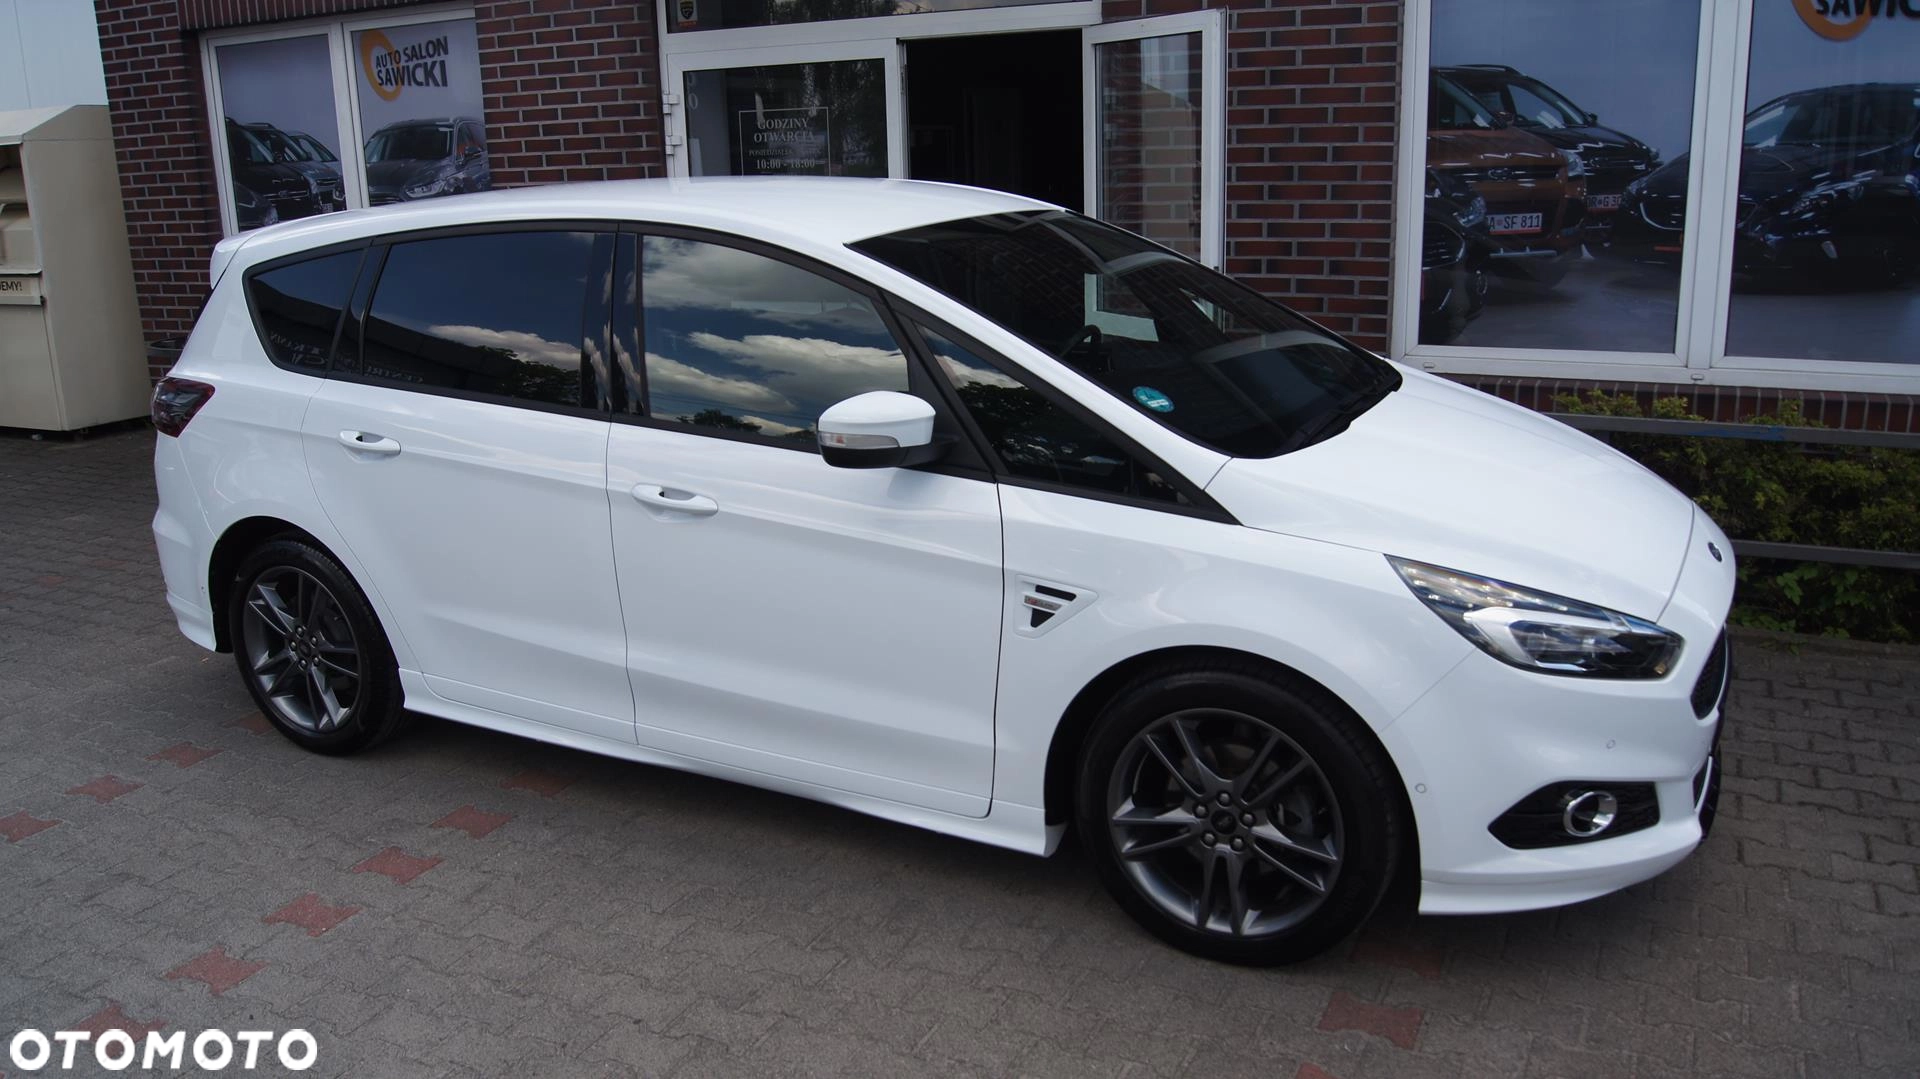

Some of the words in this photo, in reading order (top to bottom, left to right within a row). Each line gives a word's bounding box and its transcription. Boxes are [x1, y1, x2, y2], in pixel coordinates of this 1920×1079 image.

[1815, 0, 1920, 19] SAWI
[375, 50, 401, 68] AUTO
[403, 35, 449, 63] SALON
[377, 60, 449, 88] SAWICKI
[757, 117, 809, 130] GODZINY
[753, 131, 815, 143] OTWARCIA
[1503, 216, 1518, 229] SF
[1521, 215, 1540, 228] 811
[0, 281, 22, 291] EMY!
